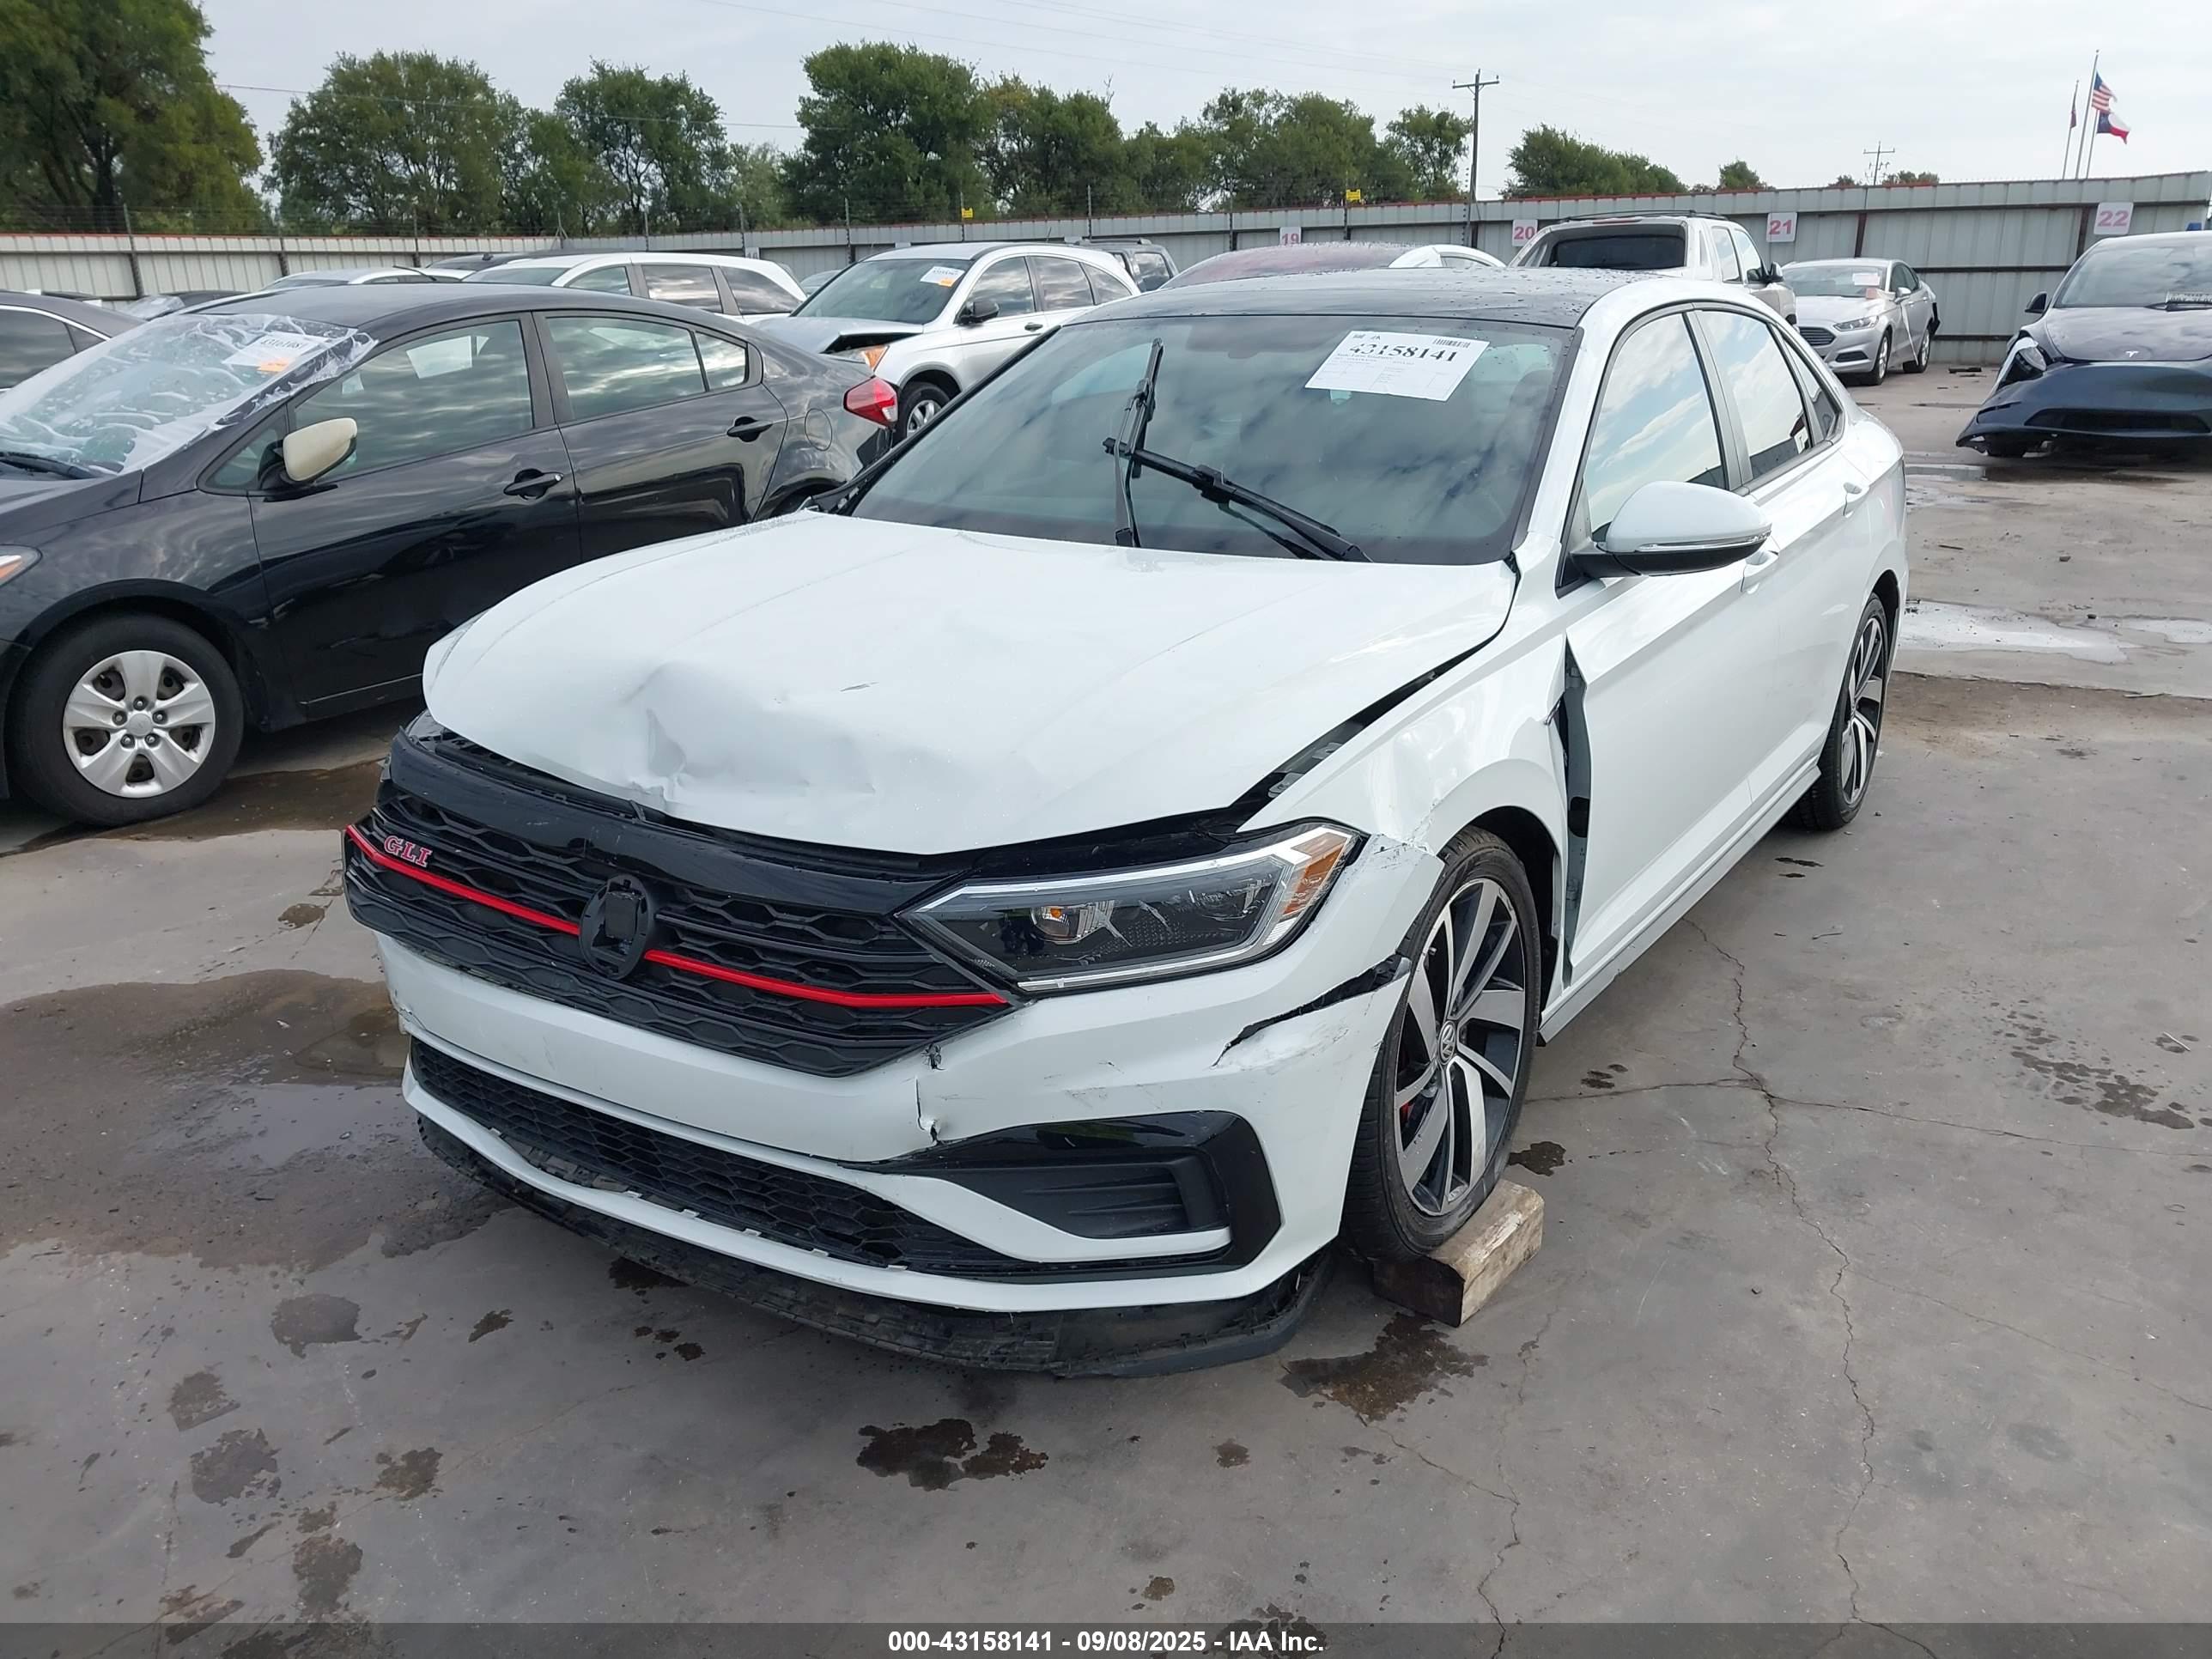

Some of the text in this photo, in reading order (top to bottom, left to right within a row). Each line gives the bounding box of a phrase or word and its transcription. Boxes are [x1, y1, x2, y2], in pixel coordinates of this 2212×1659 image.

[1769, 219, 1792, 234] 21
[2097, 210, 2130, 227] 22
[1282, 233, 1300, 246] 19
[1514, 226, 1535, 240] 20
[1349, 343, 1457, 362] 43158141
[384, 835, 433, 867] GLI
